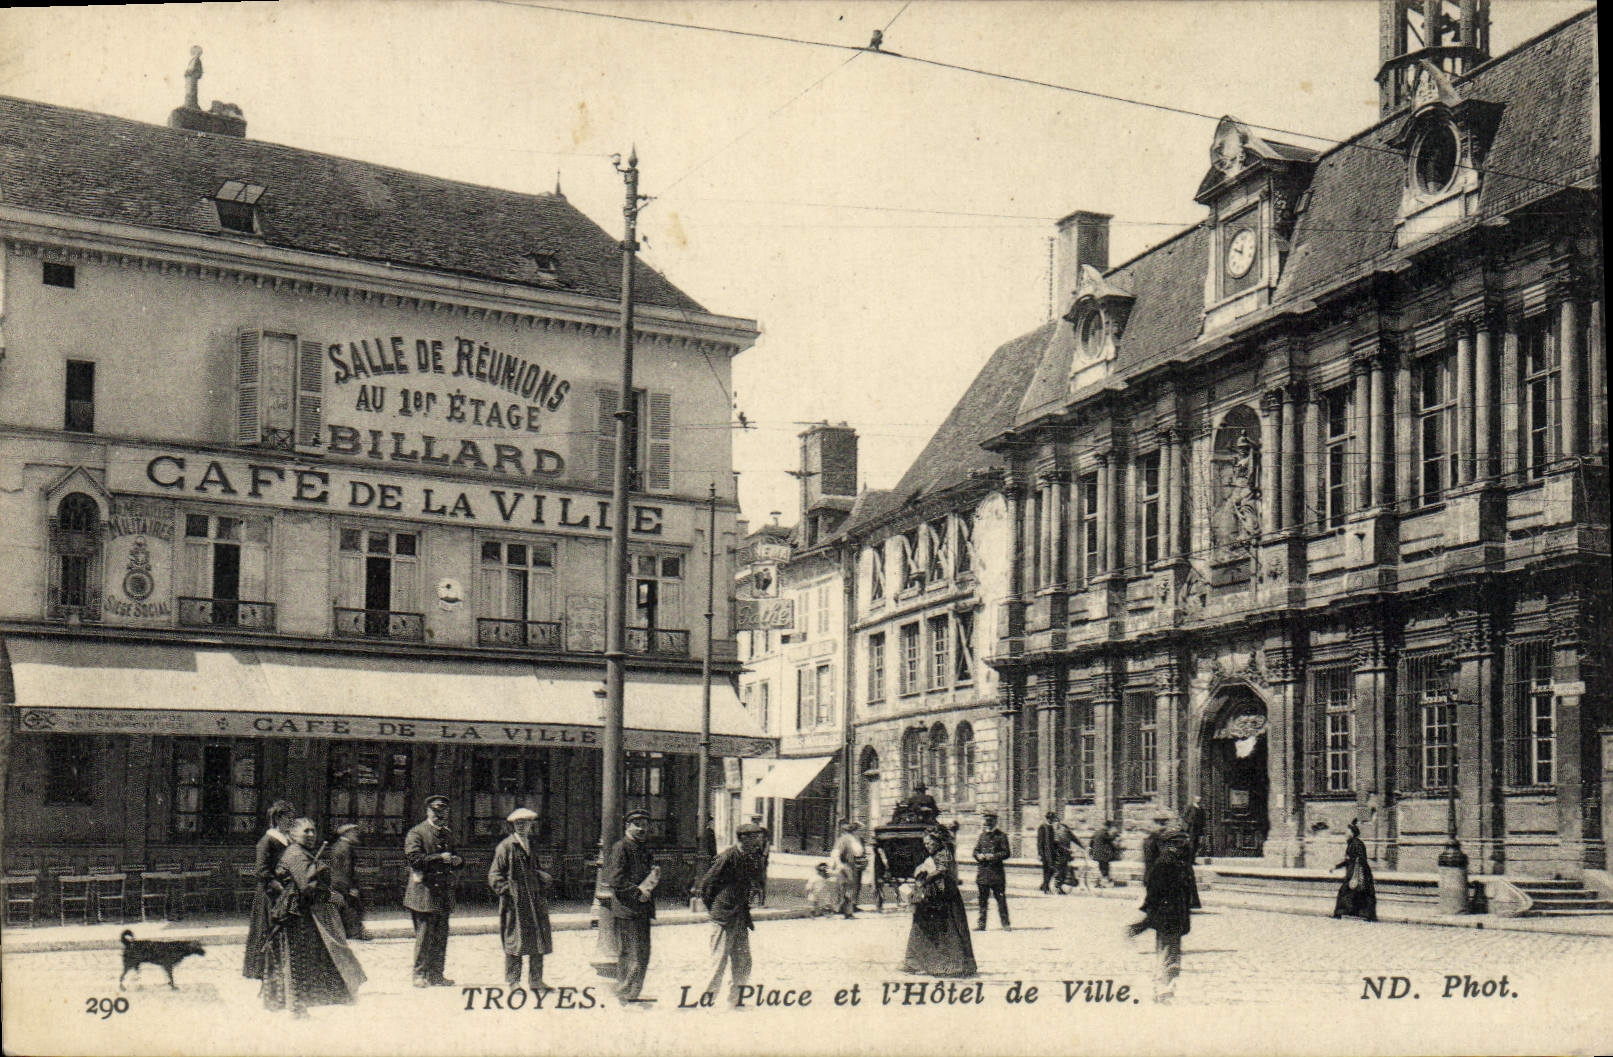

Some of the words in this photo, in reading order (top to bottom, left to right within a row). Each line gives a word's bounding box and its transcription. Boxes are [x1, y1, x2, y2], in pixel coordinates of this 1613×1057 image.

[328, 336, 409, 384] SALLE
[415, 339, 446, 375] DE
[452, 336, 571, 412] RÉUNIONS
[356, 385, 386, 412] AU
[446, 389, 542, 432] ÉTAGE
[328, 424, 567, 478] BILLARD
[349, 480, 402, 511] DE
[422, 488, 476, 519] LA
[379, 722, 416, 737] DE
[441, 725, 481, 739] LA
[503, 728, 597, 744] VILLE
